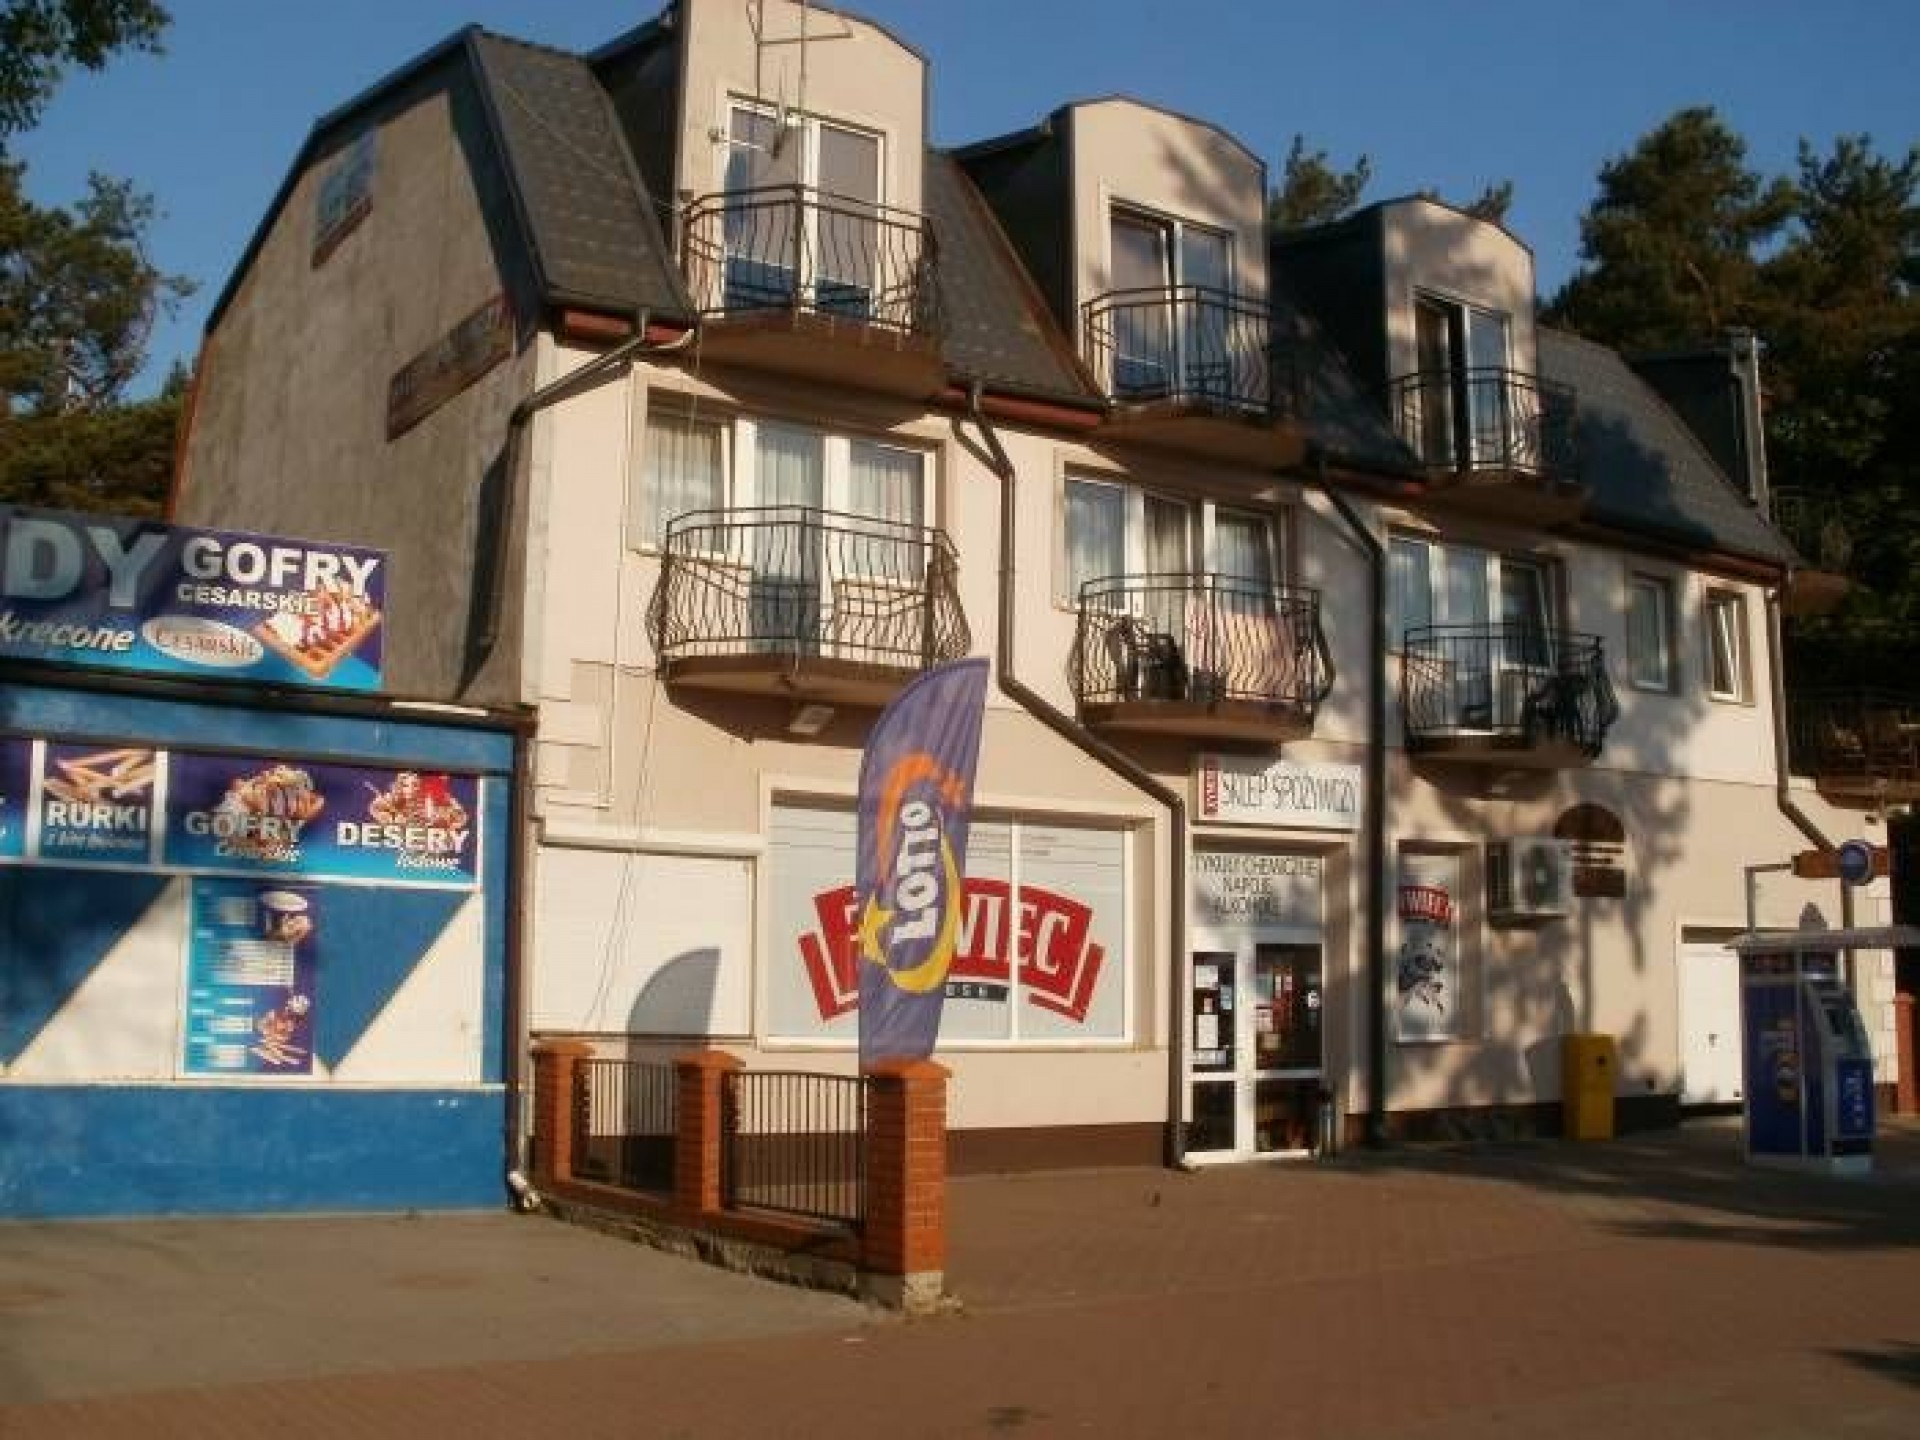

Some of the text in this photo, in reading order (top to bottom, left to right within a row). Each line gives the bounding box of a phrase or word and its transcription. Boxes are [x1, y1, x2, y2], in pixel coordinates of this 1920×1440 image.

[3, 518, 169, 607] DY
[182, 536, 380, 597] GOFRY
[1222, 771, 1268, 808] SKLEP
[46, 801, 148, 832] RURKI
[185, 811, 306, 843] GOFRY
[336, 821, 470, 853] DESERY
